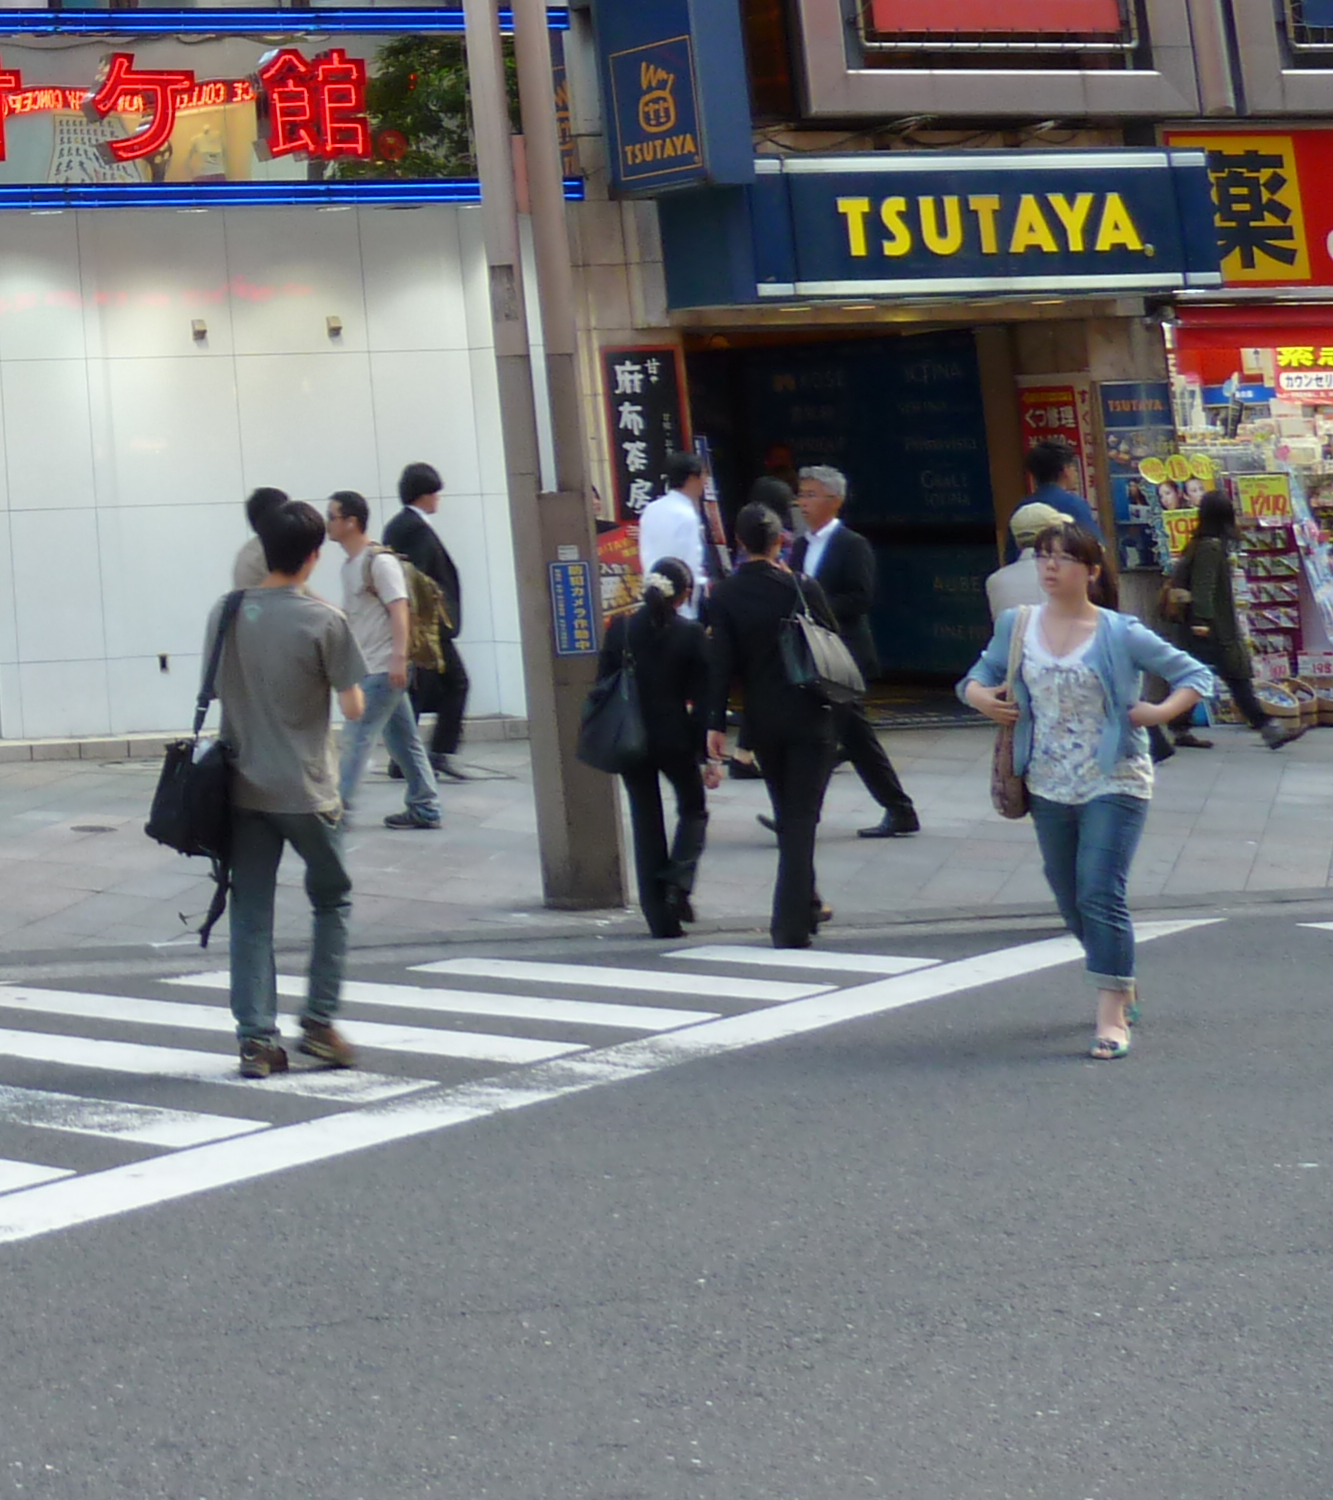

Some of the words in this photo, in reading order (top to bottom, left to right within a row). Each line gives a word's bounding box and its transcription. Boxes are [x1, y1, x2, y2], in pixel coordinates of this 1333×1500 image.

[624, 134, 696, 167] TSUTAYA
[835, 192, 1144, 257] TSUTAYA
[1206, 150, 1299, 269] 薬
[1024, 405, 1077, 428] くつ修理
[1107, 399, 1164, 413] TSUTAYA
